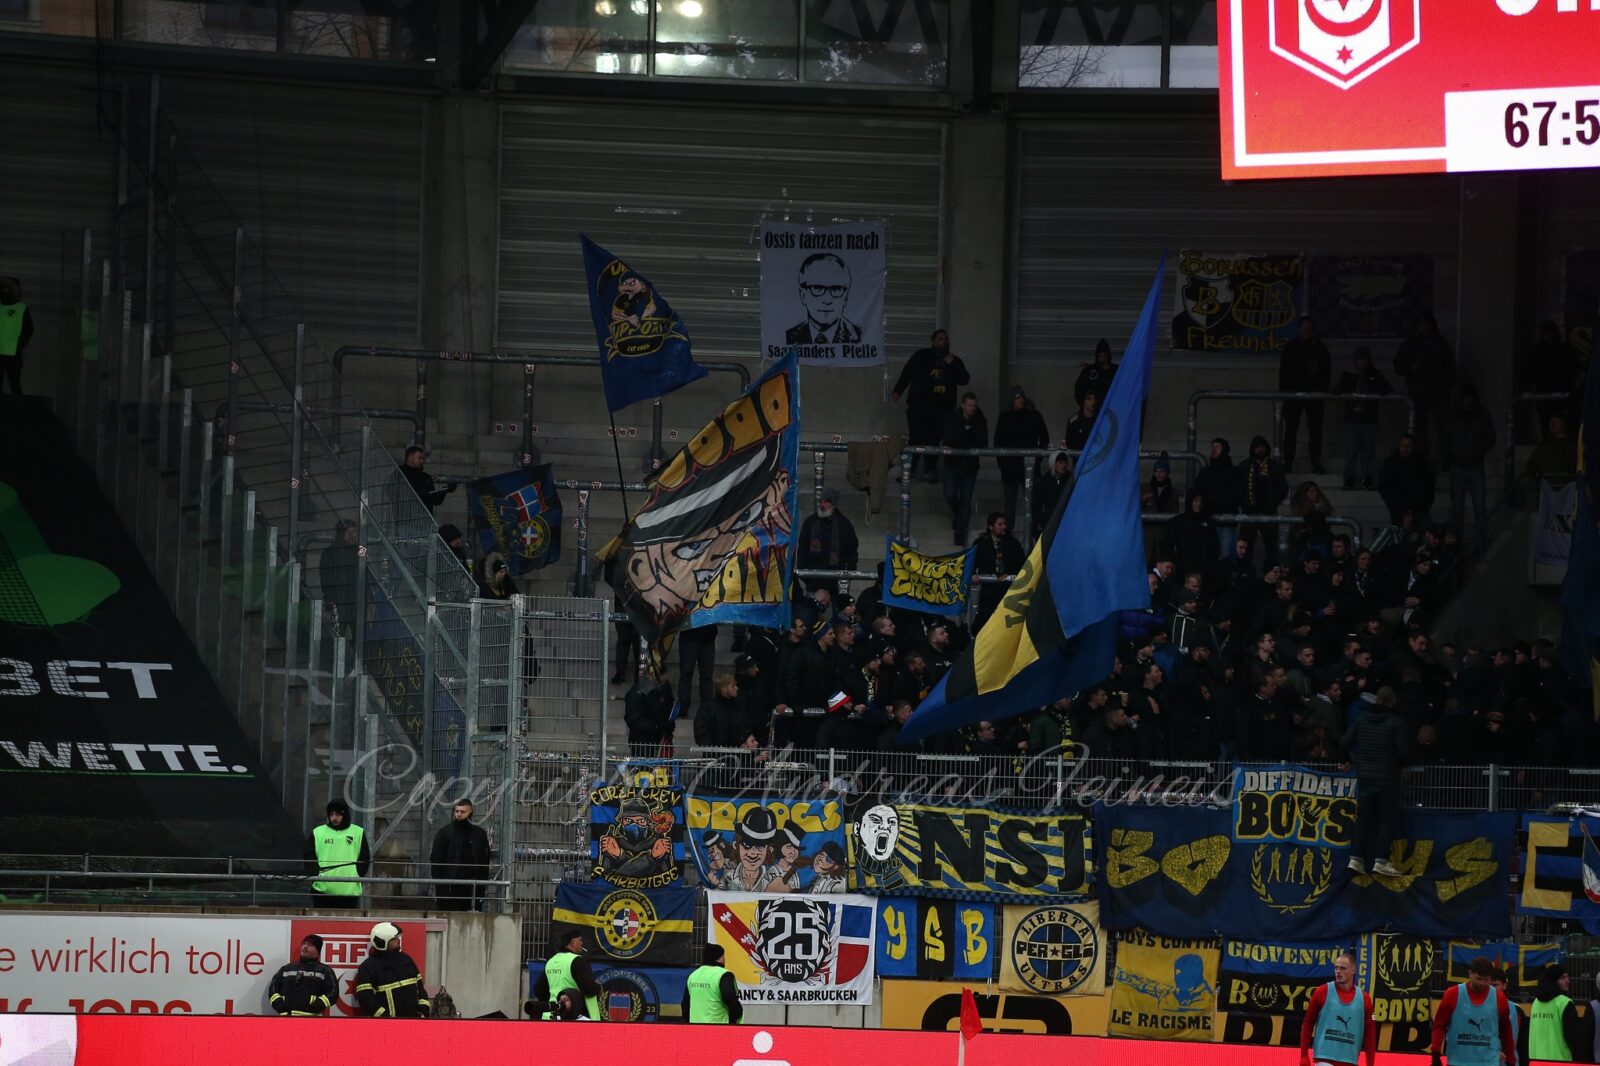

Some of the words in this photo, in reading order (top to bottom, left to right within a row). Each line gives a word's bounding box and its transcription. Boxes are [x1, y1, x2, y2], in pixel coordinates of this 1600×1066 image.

[765, 231, 795, 249] Ossis
[799, 231, 842, 250] tanzen
[846, 231, 879, 250] nach
[0, 657, 173, 699] BET
[1237, 792, 1358, 844] BOYS
[767, 911, 820, 961] 25
[31, 937, 170, 975] wirklich
[188, 939, 265, 976] tolle
[324, 943, 376, 963] HF
[1016, 940, 1048, 959] PER
[784, 963, 803, 975] ANS
[1020, 962, 1088, 990] ULTRAS
[737, 989, 765, 1001] ANCY
[1111, 1008, 1133, 1027] LE
[1137, 1012, 1212, 1030] RACISME
[1375, 997, 1431, 1023] BOYS
